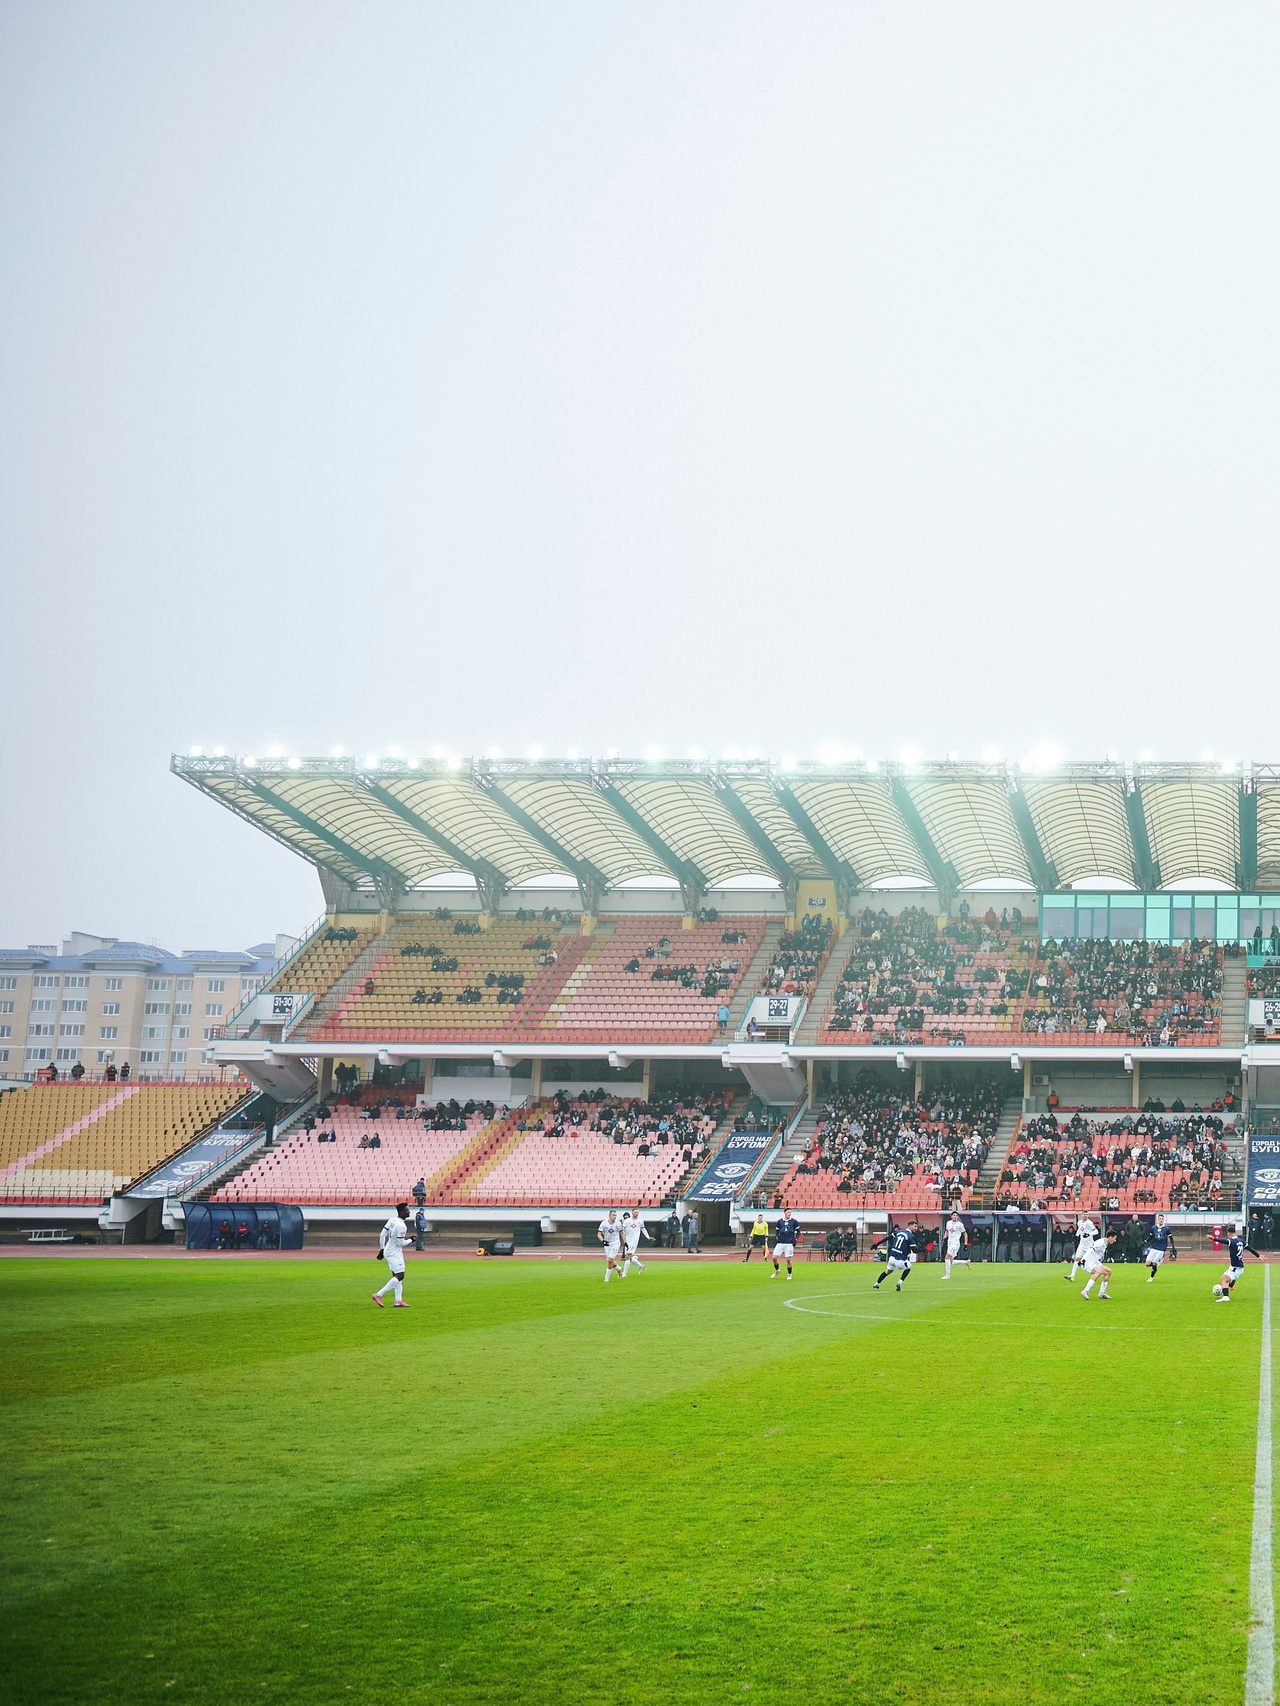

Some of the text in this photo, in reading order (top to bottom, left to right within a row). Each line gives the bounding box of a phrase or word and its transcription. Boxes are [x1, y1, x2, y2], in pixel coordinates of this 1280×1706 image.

[274, 997, 292, 1007] 31-30
[769, 1000, 787, 1009] 29-27
[895, 1235, 905, 1249] 11
